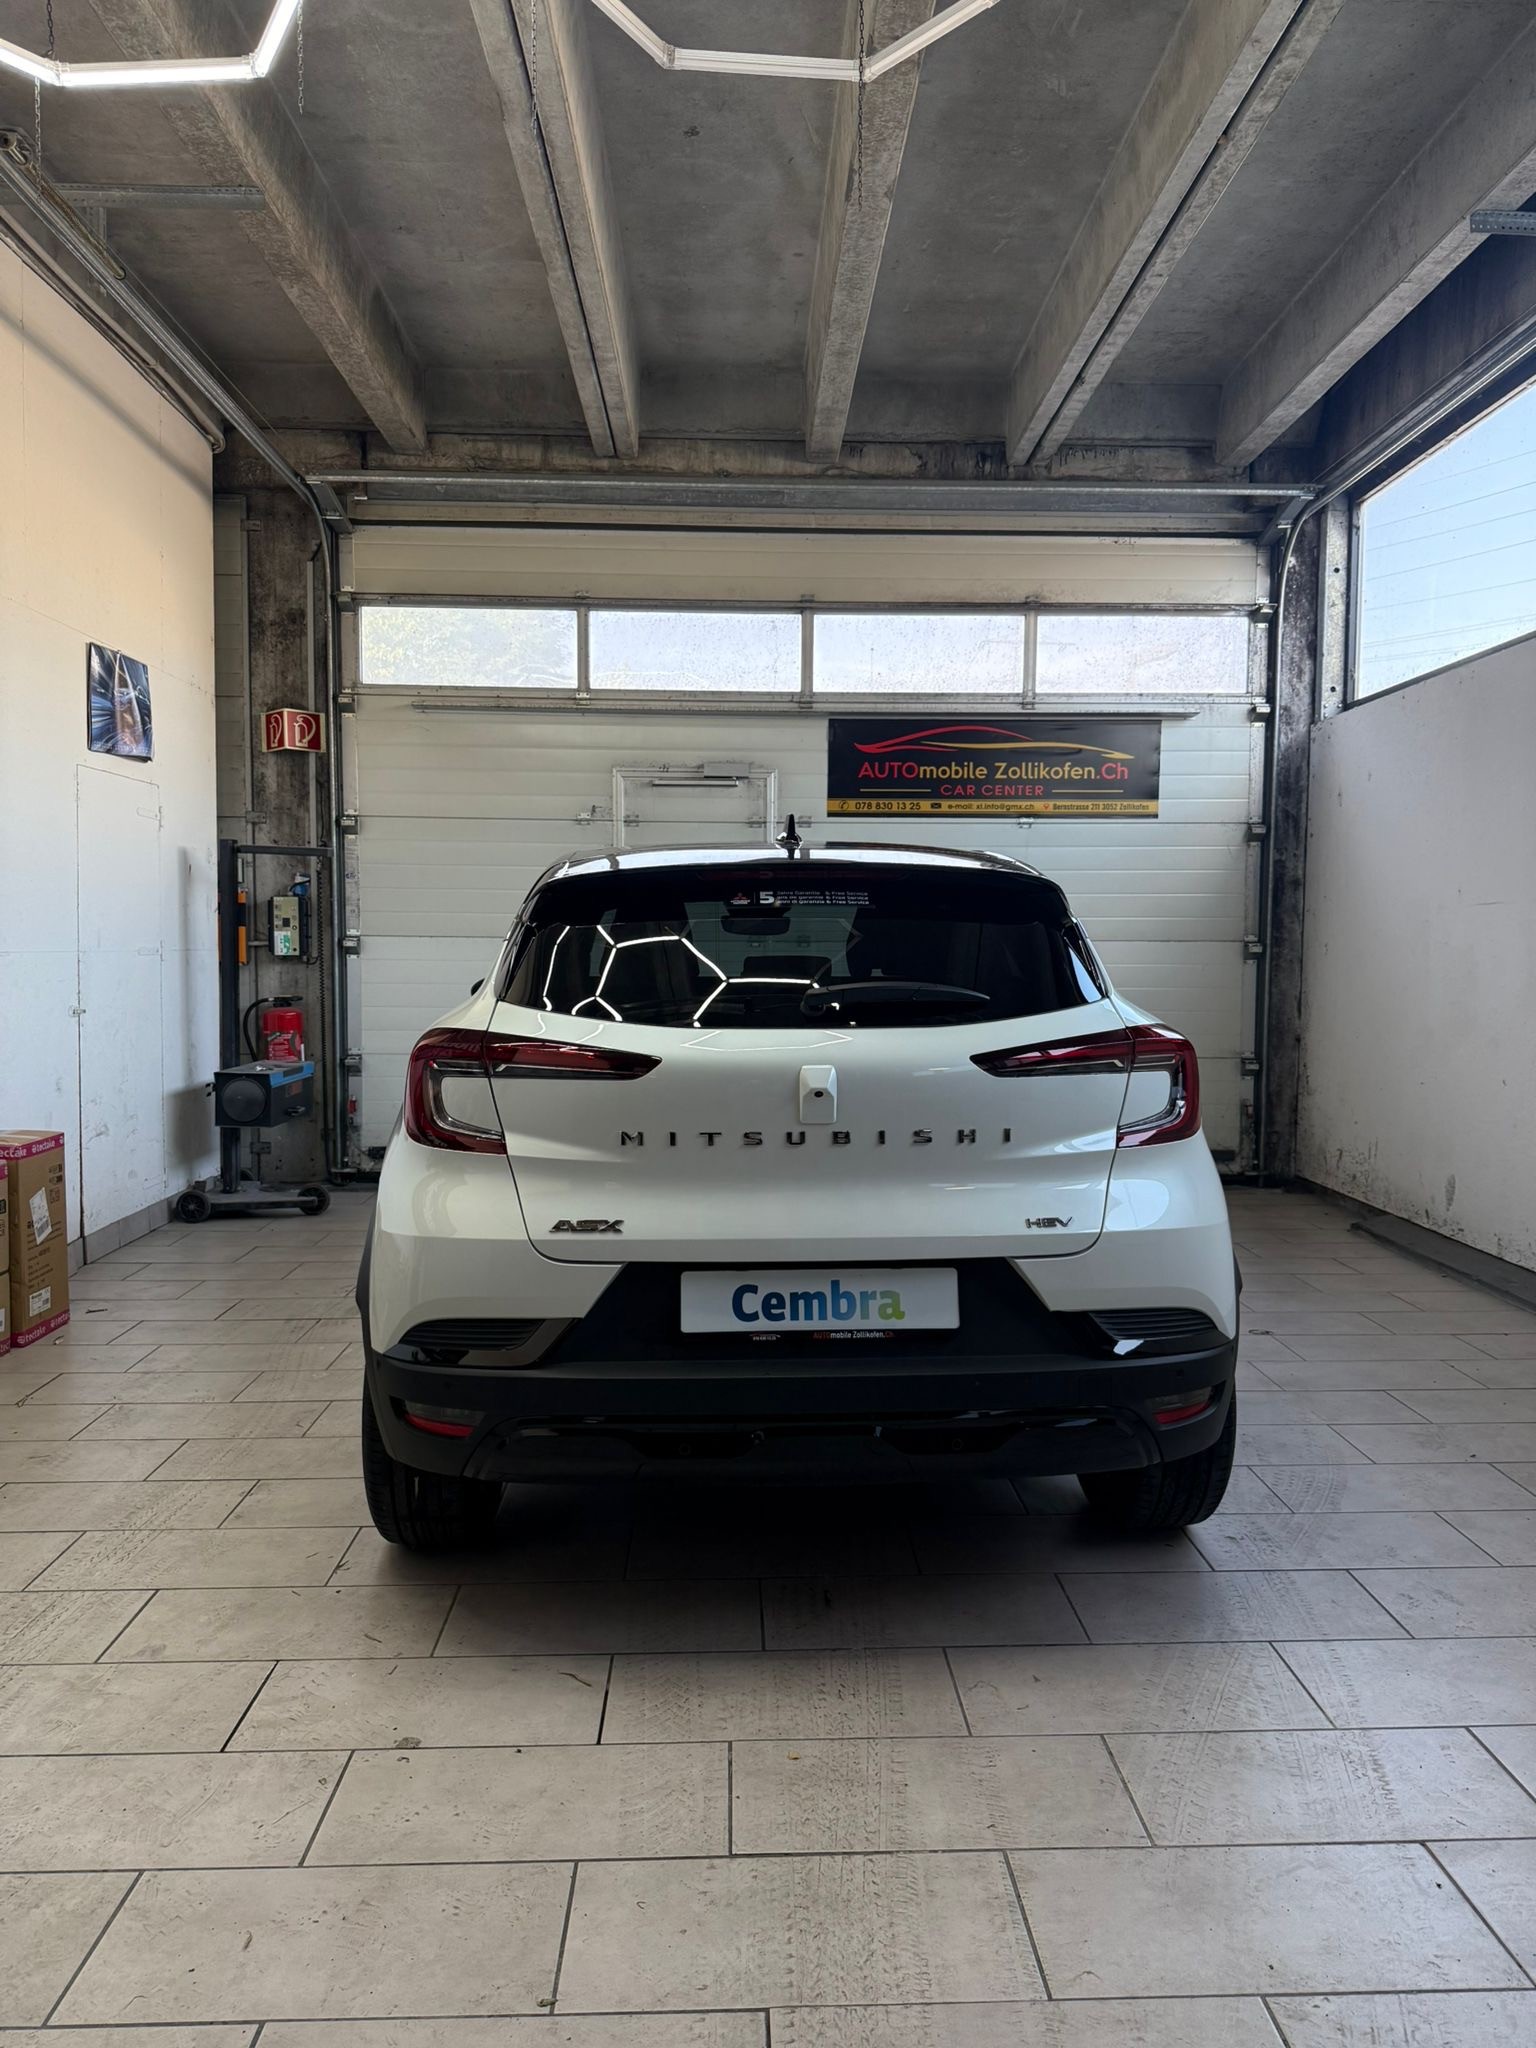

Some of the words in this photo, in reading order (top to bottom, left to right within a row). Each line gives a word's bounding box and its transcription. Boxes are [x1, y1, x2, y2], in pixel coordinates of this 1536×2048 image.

[857, 761, 988, 779] AUTOmobile
[994, 761, 1129, 780] Zollikofen.Ch
[940, 784, 975, 796] CAR
[981, 784, 1045, 796] CENTER
[855, 801, 873, 811] 078
[875, 801, 893, 811] 830
[896, 801, 907, 811] 13
[909, 801, 921, 811] 25
[1102, 802, 1117, 811] 3052
[1119, 802, 1149, 811] Zollikofen
[759, 891, 775, 904] 5
[620, 1126, 1012, 1147] MITSUBISHI
[549, 1218, 625, 1234] ASX
[1024, 1215, 1073, 1229] HEV
[731, 1279, 906, 1323] Cembra
